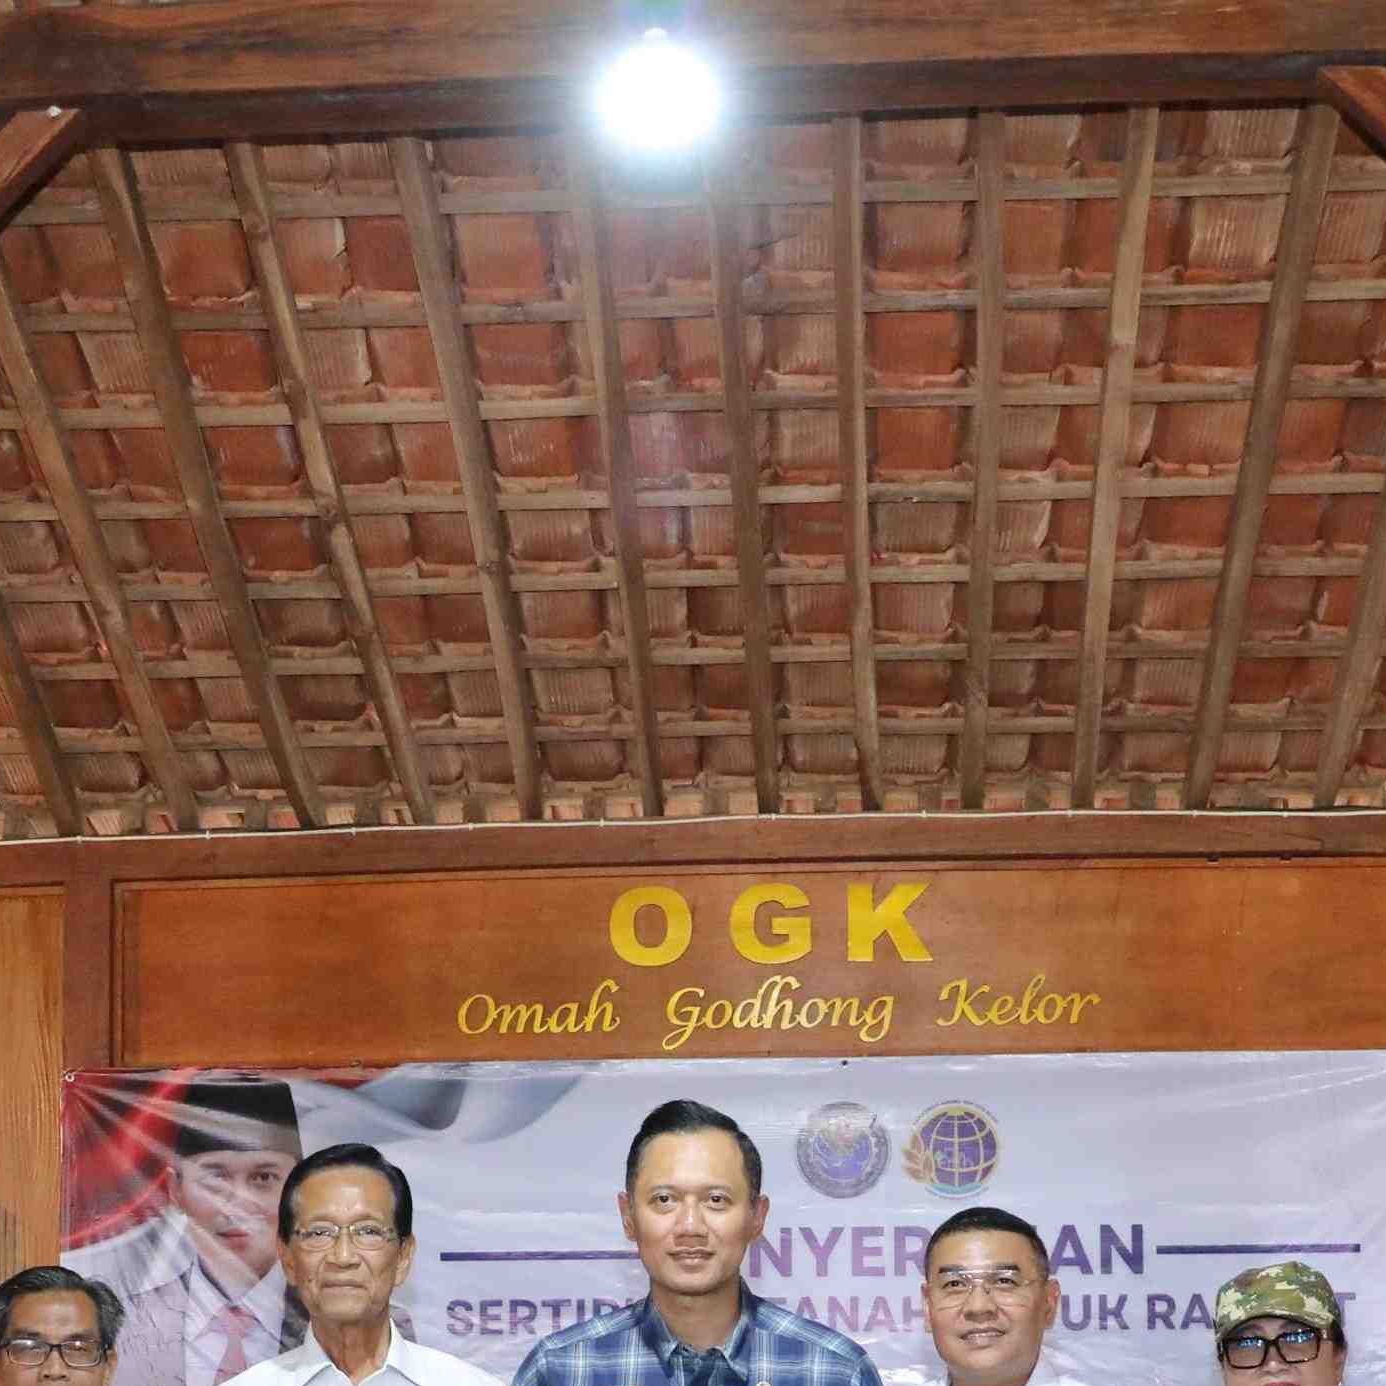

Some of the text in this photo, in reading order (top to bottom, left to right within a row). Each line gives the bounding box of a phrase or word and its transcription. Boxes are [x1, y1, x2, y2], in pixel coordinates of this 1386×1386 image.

[457, 973, 1101, 1050] Omah Godhong Kelor
[749, 1224, 1143, 1277] NYERAN
